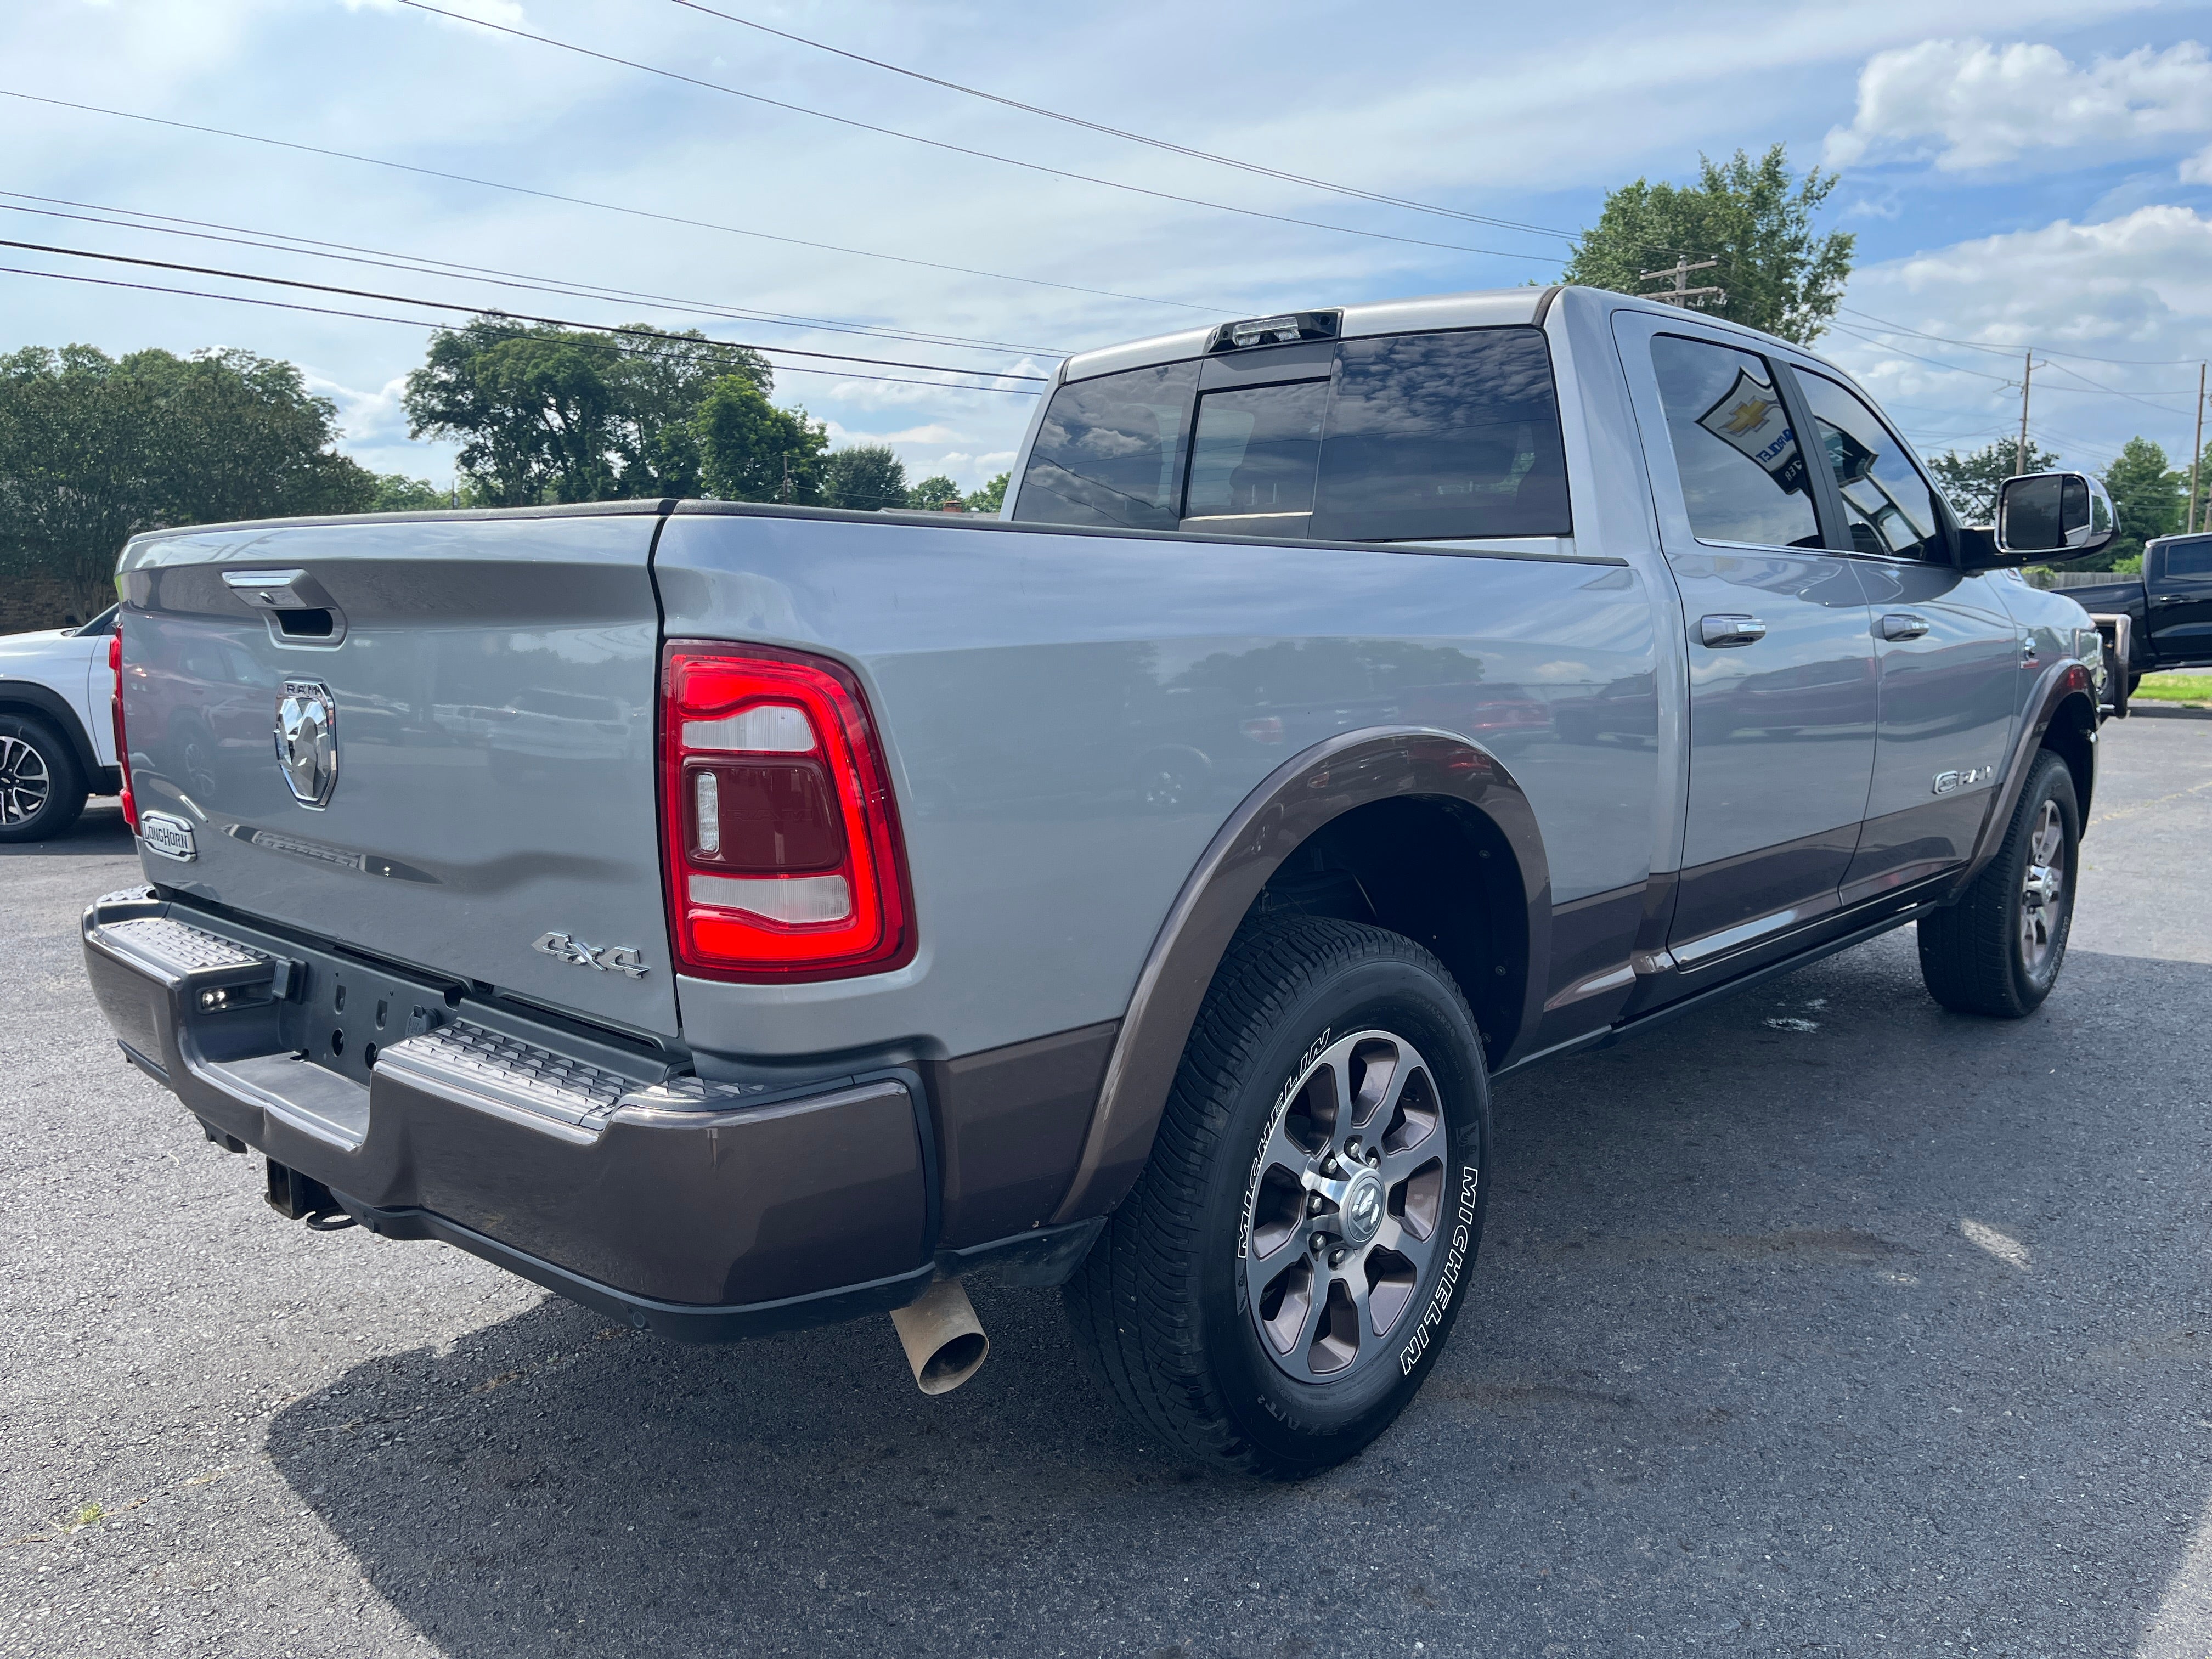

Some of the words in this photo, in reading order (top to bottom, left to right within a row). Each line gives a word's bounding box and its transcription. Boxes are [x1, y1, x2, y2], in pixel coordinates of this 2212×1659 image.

[286, 684, 321, 695] RAM
[726, 808, 812, 821] RAM
[1400, 1166, 1478, 1375] MICHELIN
